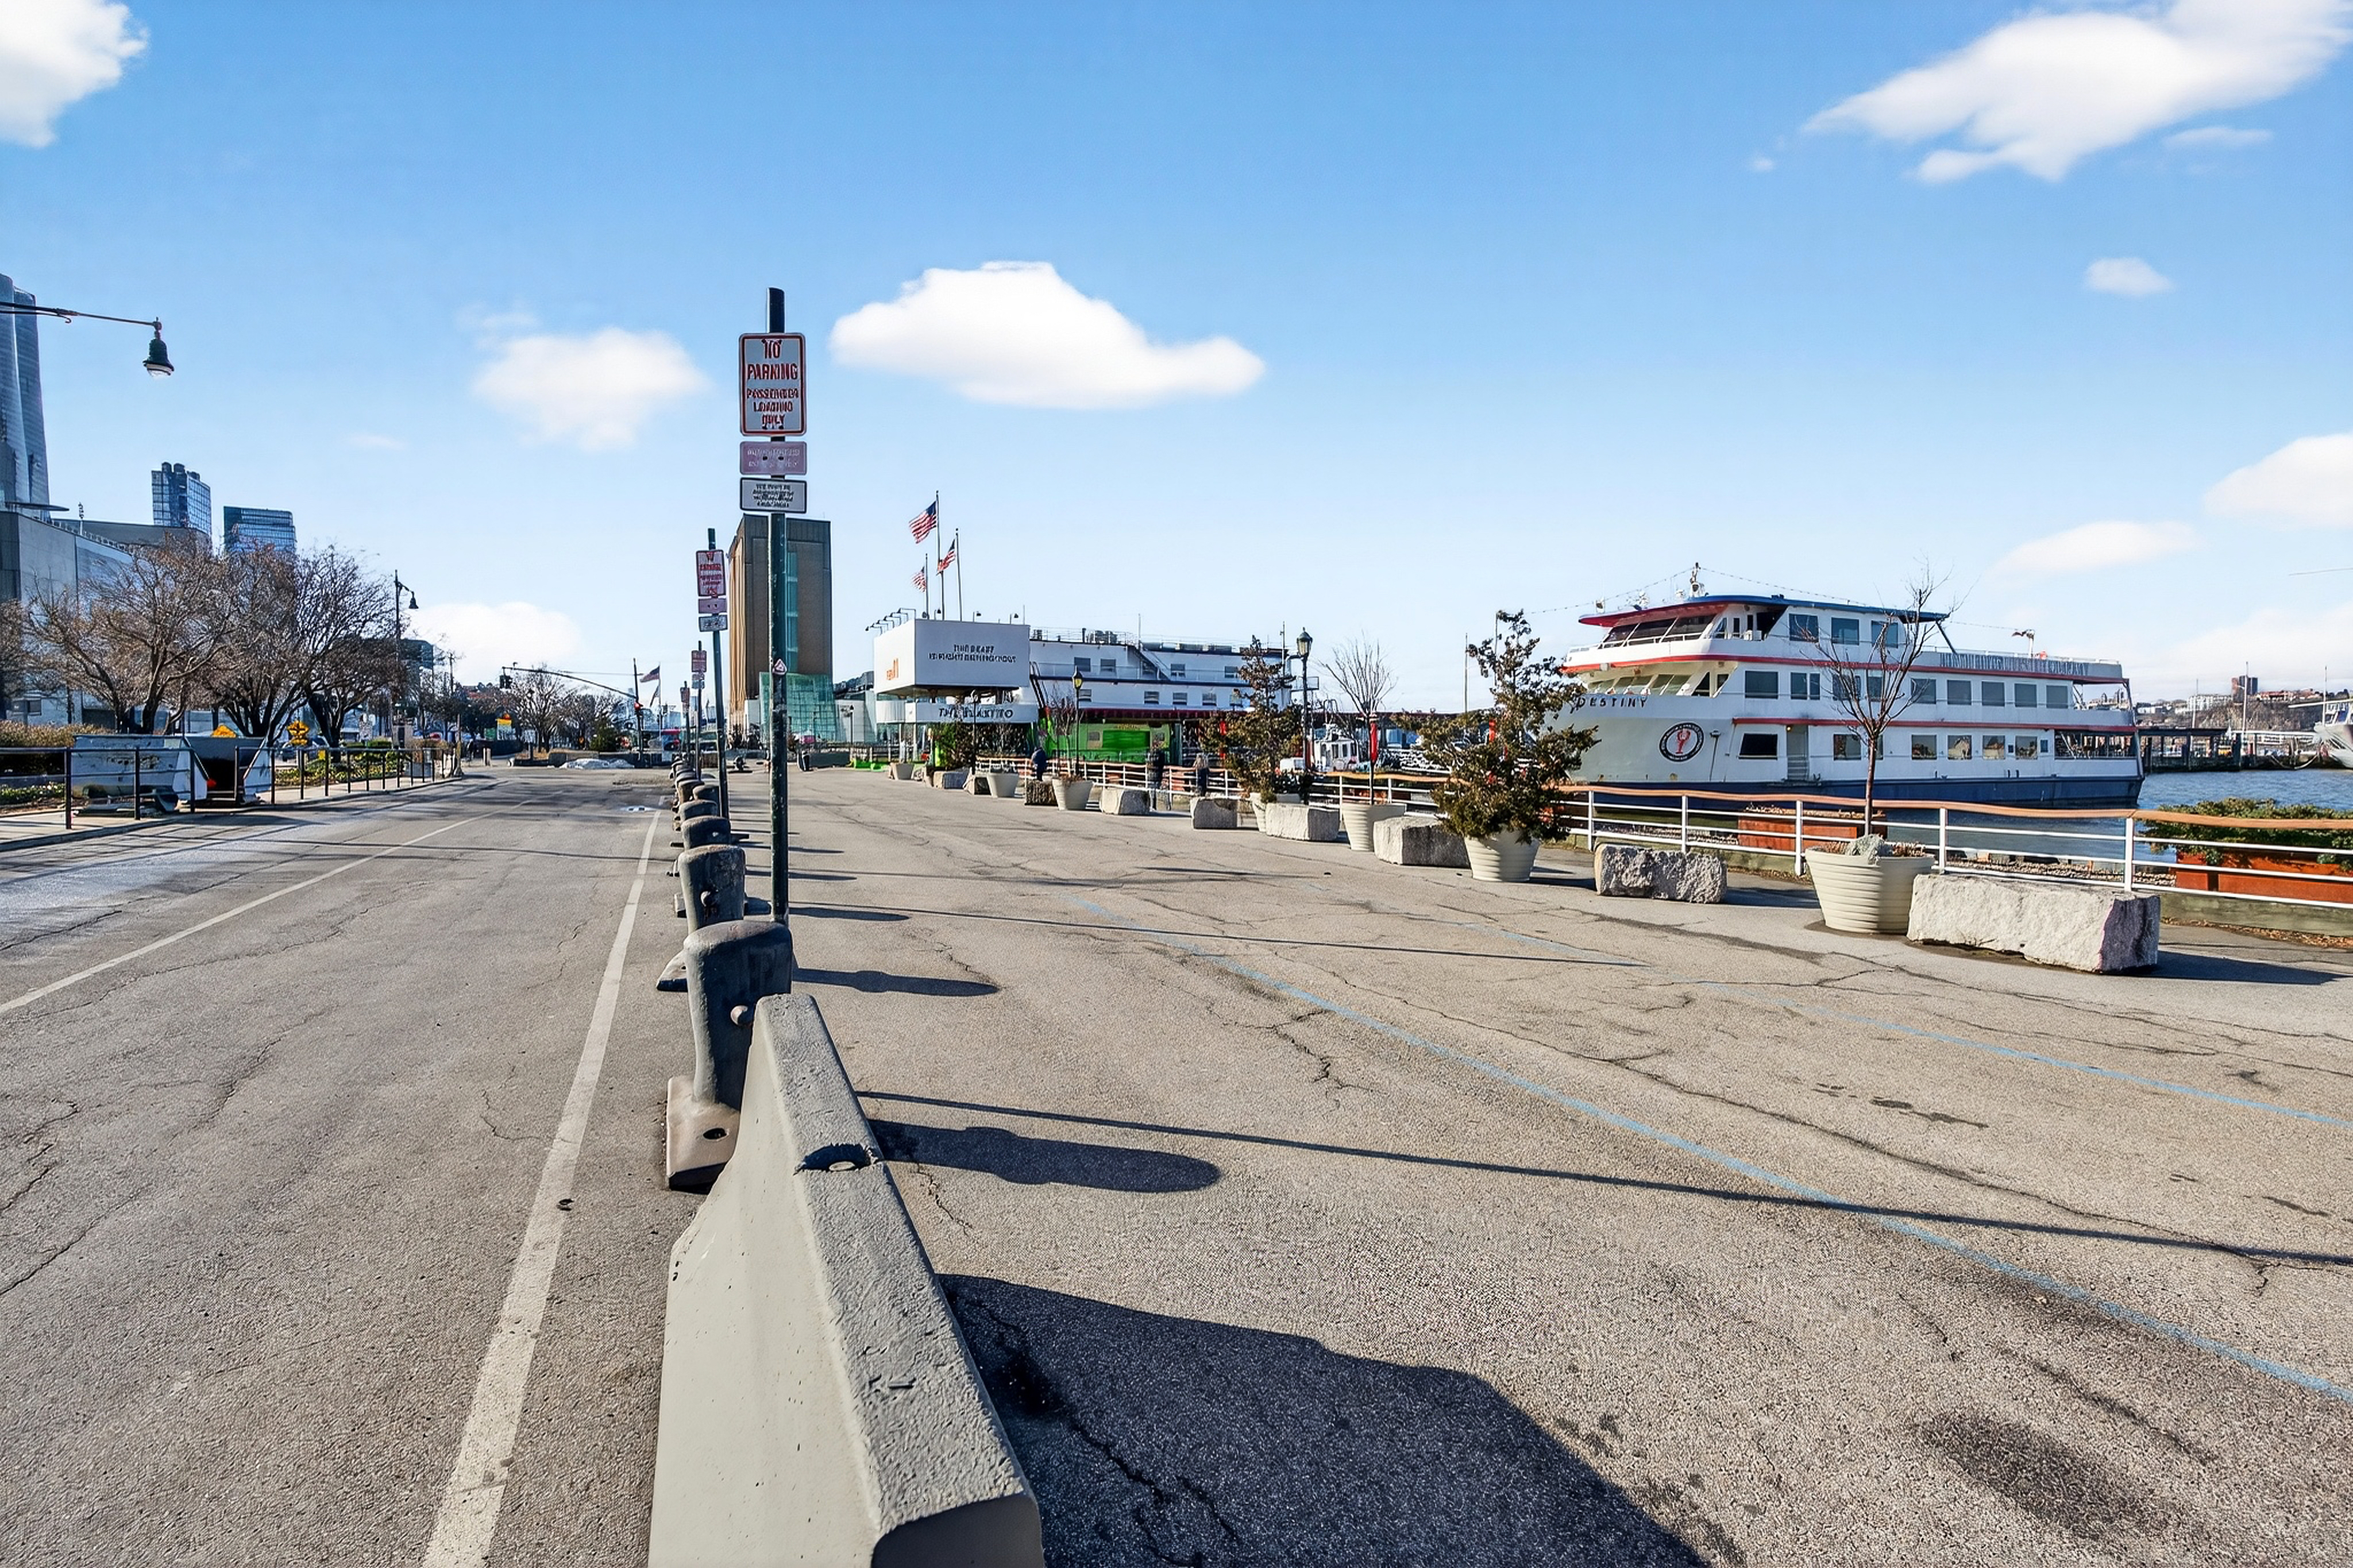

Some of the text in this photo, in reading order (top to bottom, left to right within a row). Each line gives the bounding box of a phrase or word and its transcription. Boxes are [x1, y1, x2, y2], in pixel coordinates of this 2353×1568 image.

[747, 363, 798, 380] PARKING
[747, 388, 799, 399] PASSENGER
[753, 401, 793, 412] LOADING
[1577, 697, 1648, 708] DESTINY
